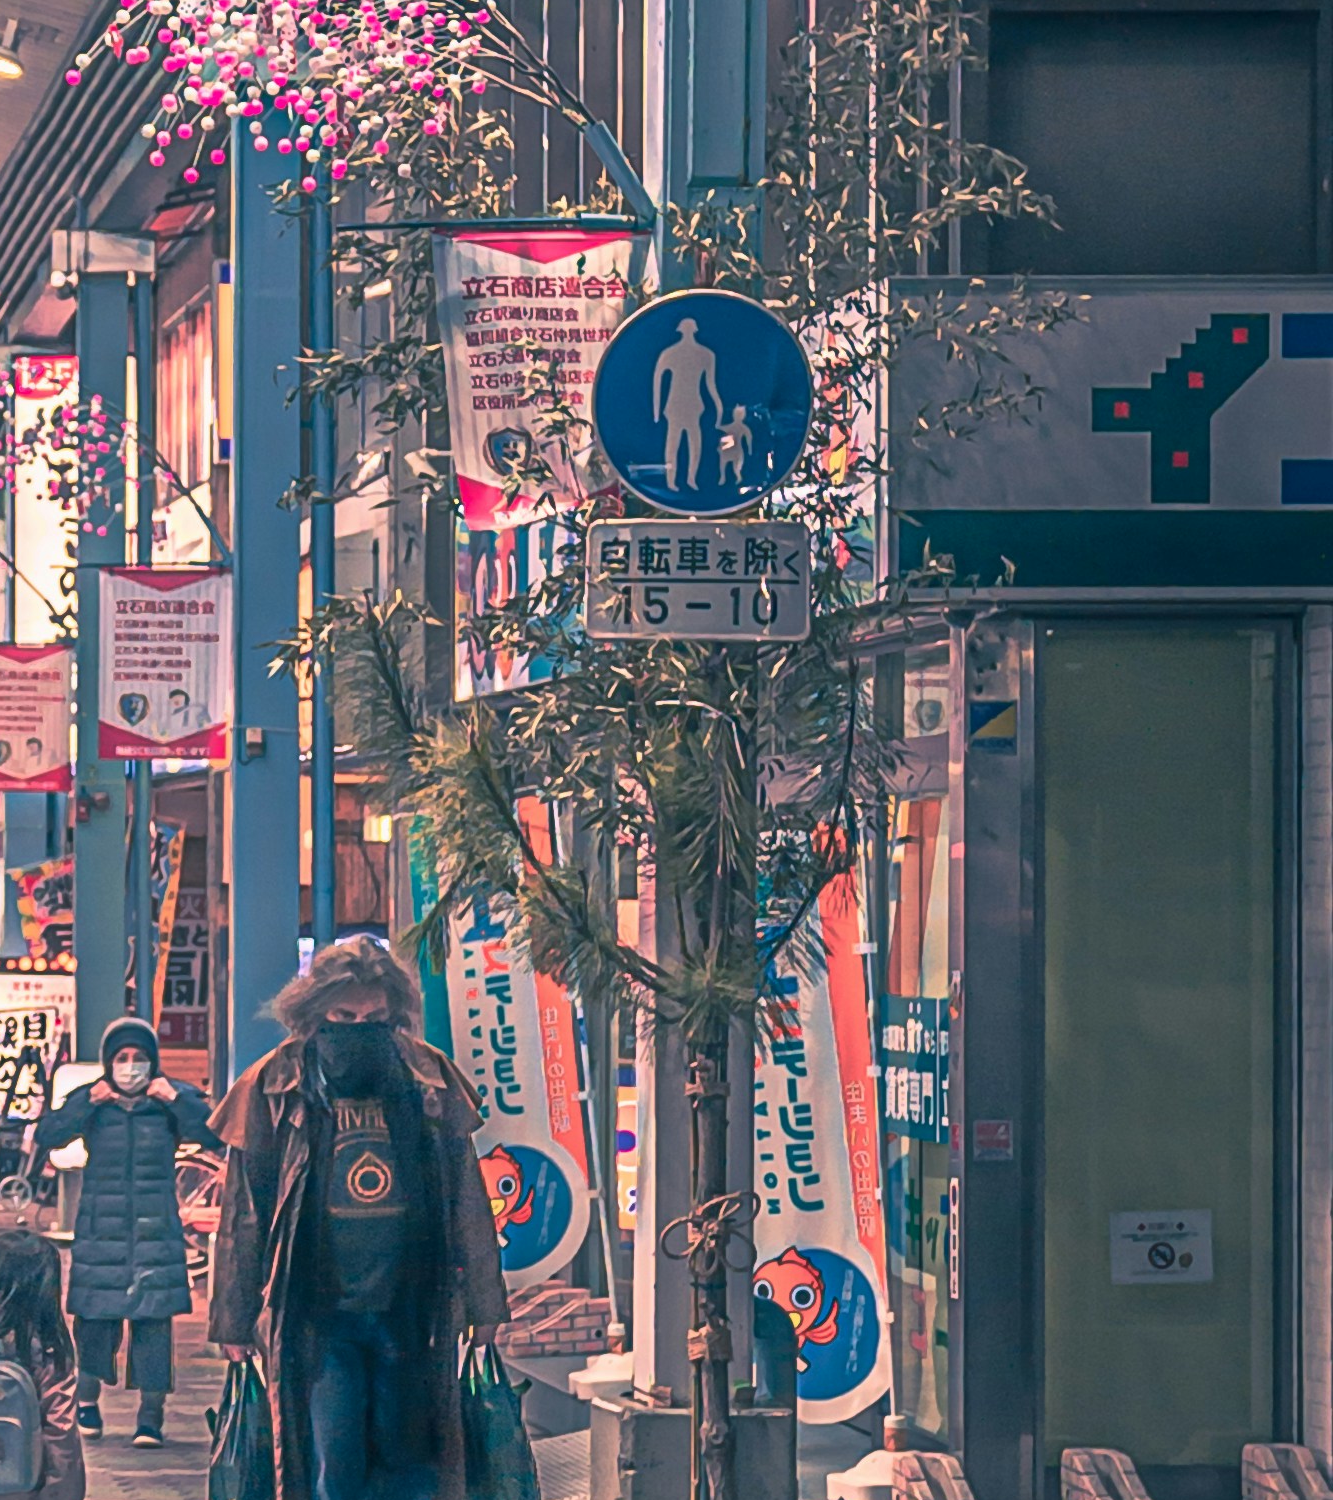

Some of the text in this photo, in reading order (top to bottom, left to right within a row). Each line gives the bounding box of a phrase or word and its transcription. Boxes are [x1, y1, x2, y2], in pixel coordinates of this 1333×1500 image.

[462, 275, 627, 299] 立石商店連合会
[600, 535, 800, 577] 自転車を除く
[885, 1065, 934, 1126] 賃貸専門
